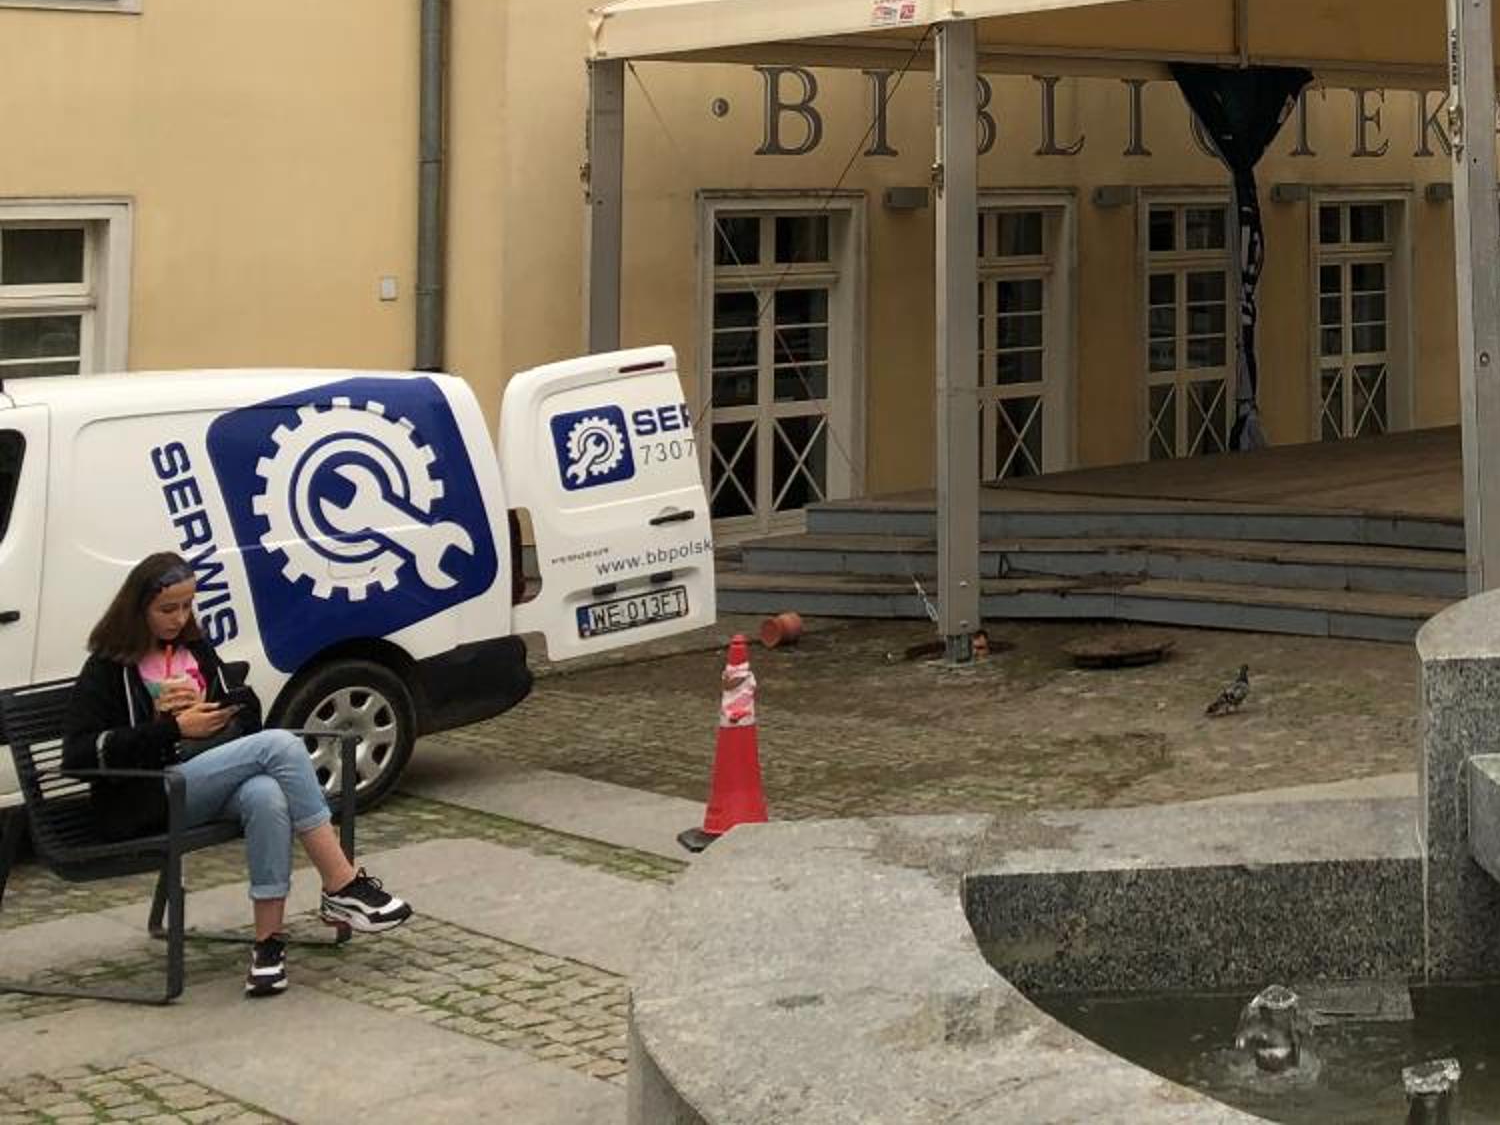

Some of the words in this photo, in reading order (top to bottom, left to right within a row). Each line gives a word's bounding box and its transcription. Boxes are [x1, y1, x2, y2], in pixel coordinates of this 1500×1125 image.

[639, 437, 695, 465] 7307
[151, 441, 238, 648] SERWIS
[592, 605, 621, 628] WE
